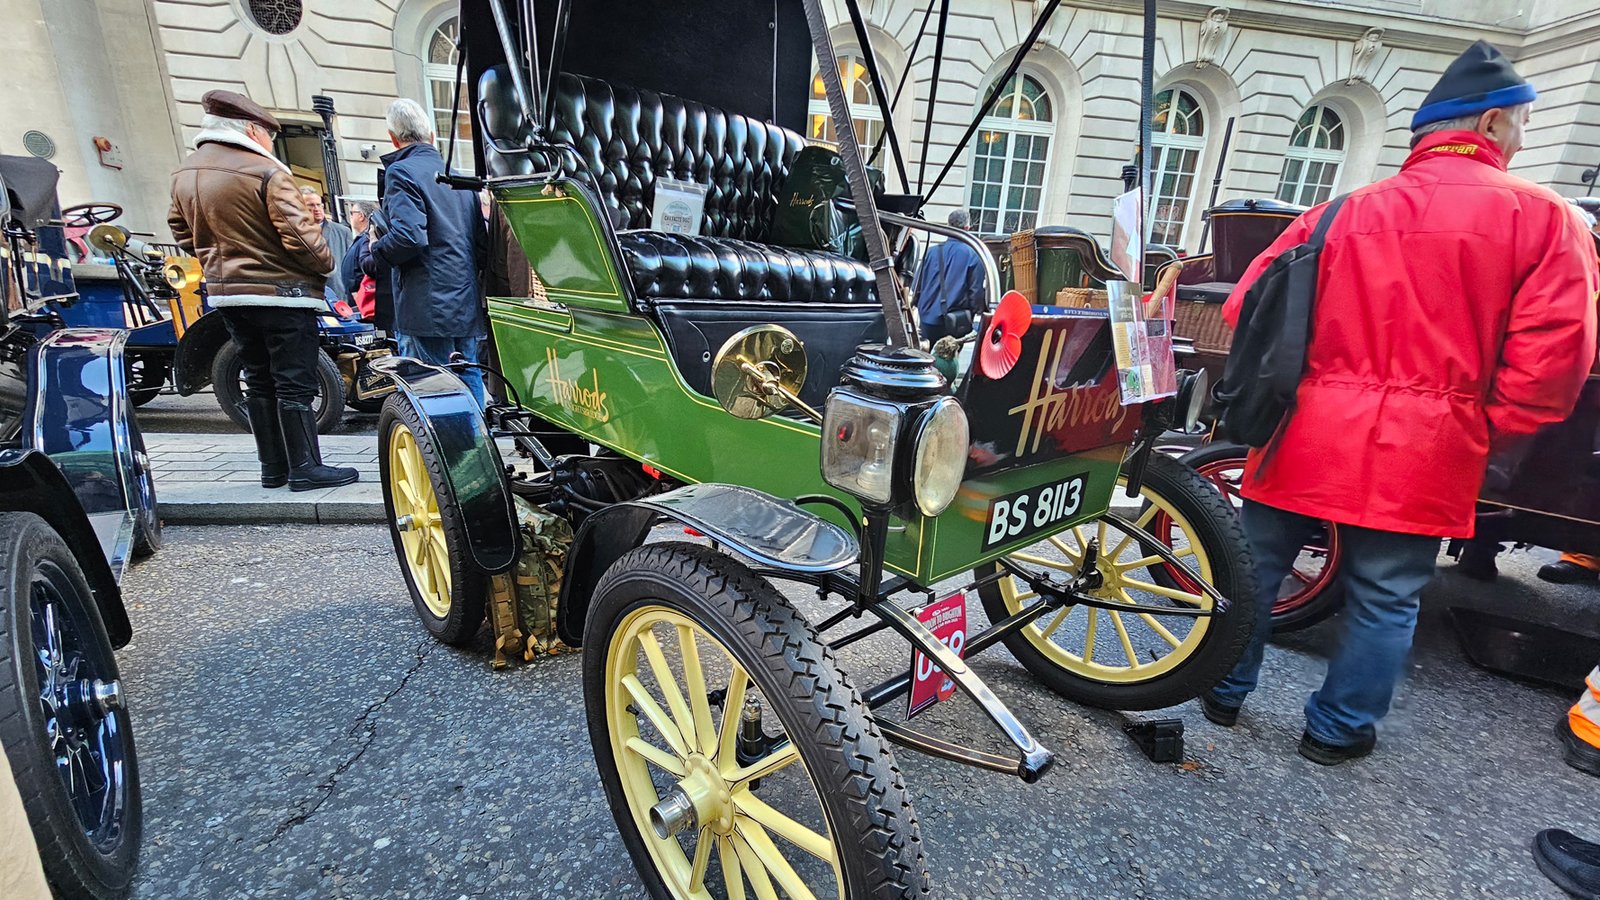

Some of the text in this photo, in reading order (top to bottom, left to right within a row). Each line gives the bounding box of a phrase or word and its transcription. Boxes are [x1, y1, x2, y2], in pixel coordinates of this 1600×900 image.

[789, 191, 815, 208] Harrods
[545, 346, 610, 423] Harrods
[987, 477, 1083, 546] BS 8113
